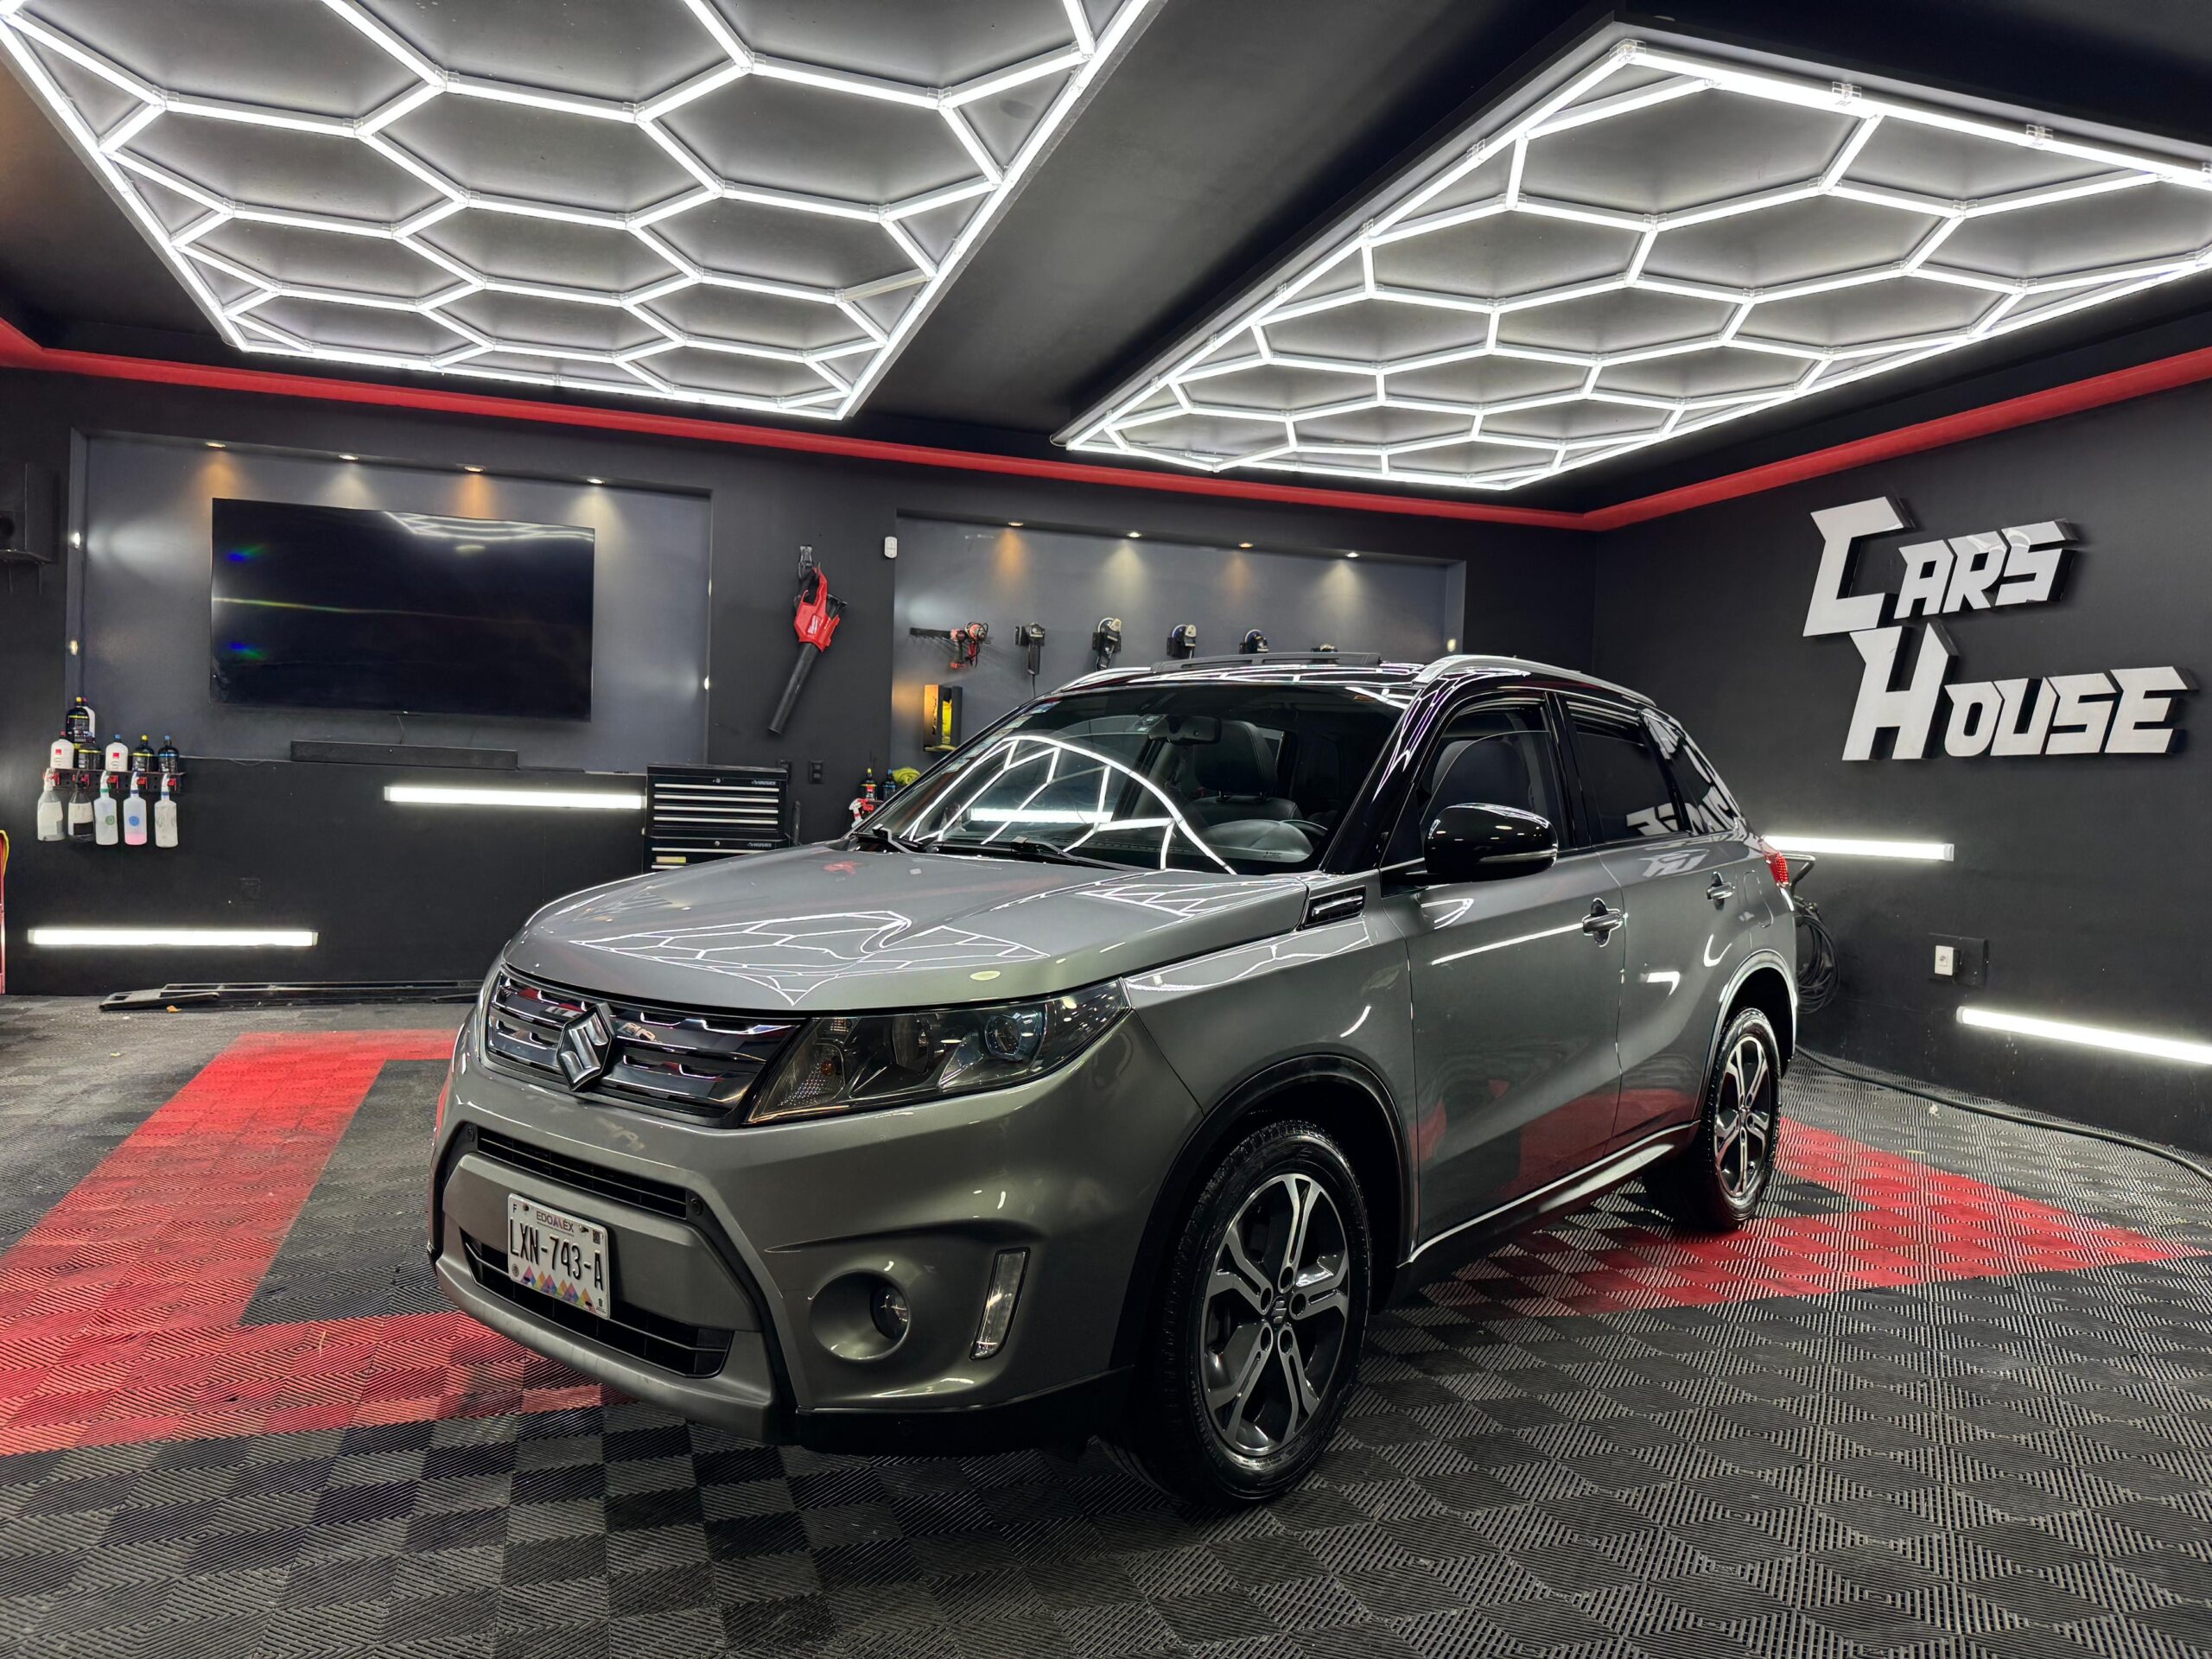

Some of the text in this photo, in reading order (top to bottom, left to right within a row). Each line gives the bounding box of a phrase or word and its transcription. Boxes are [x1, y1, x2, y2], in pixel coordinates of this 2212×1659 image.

[1802, 496, 2075, 638] CARS
[1841, 622, 2195, 760] HOUSE
[509, 1217, 604, 1292] LXN-743-A
